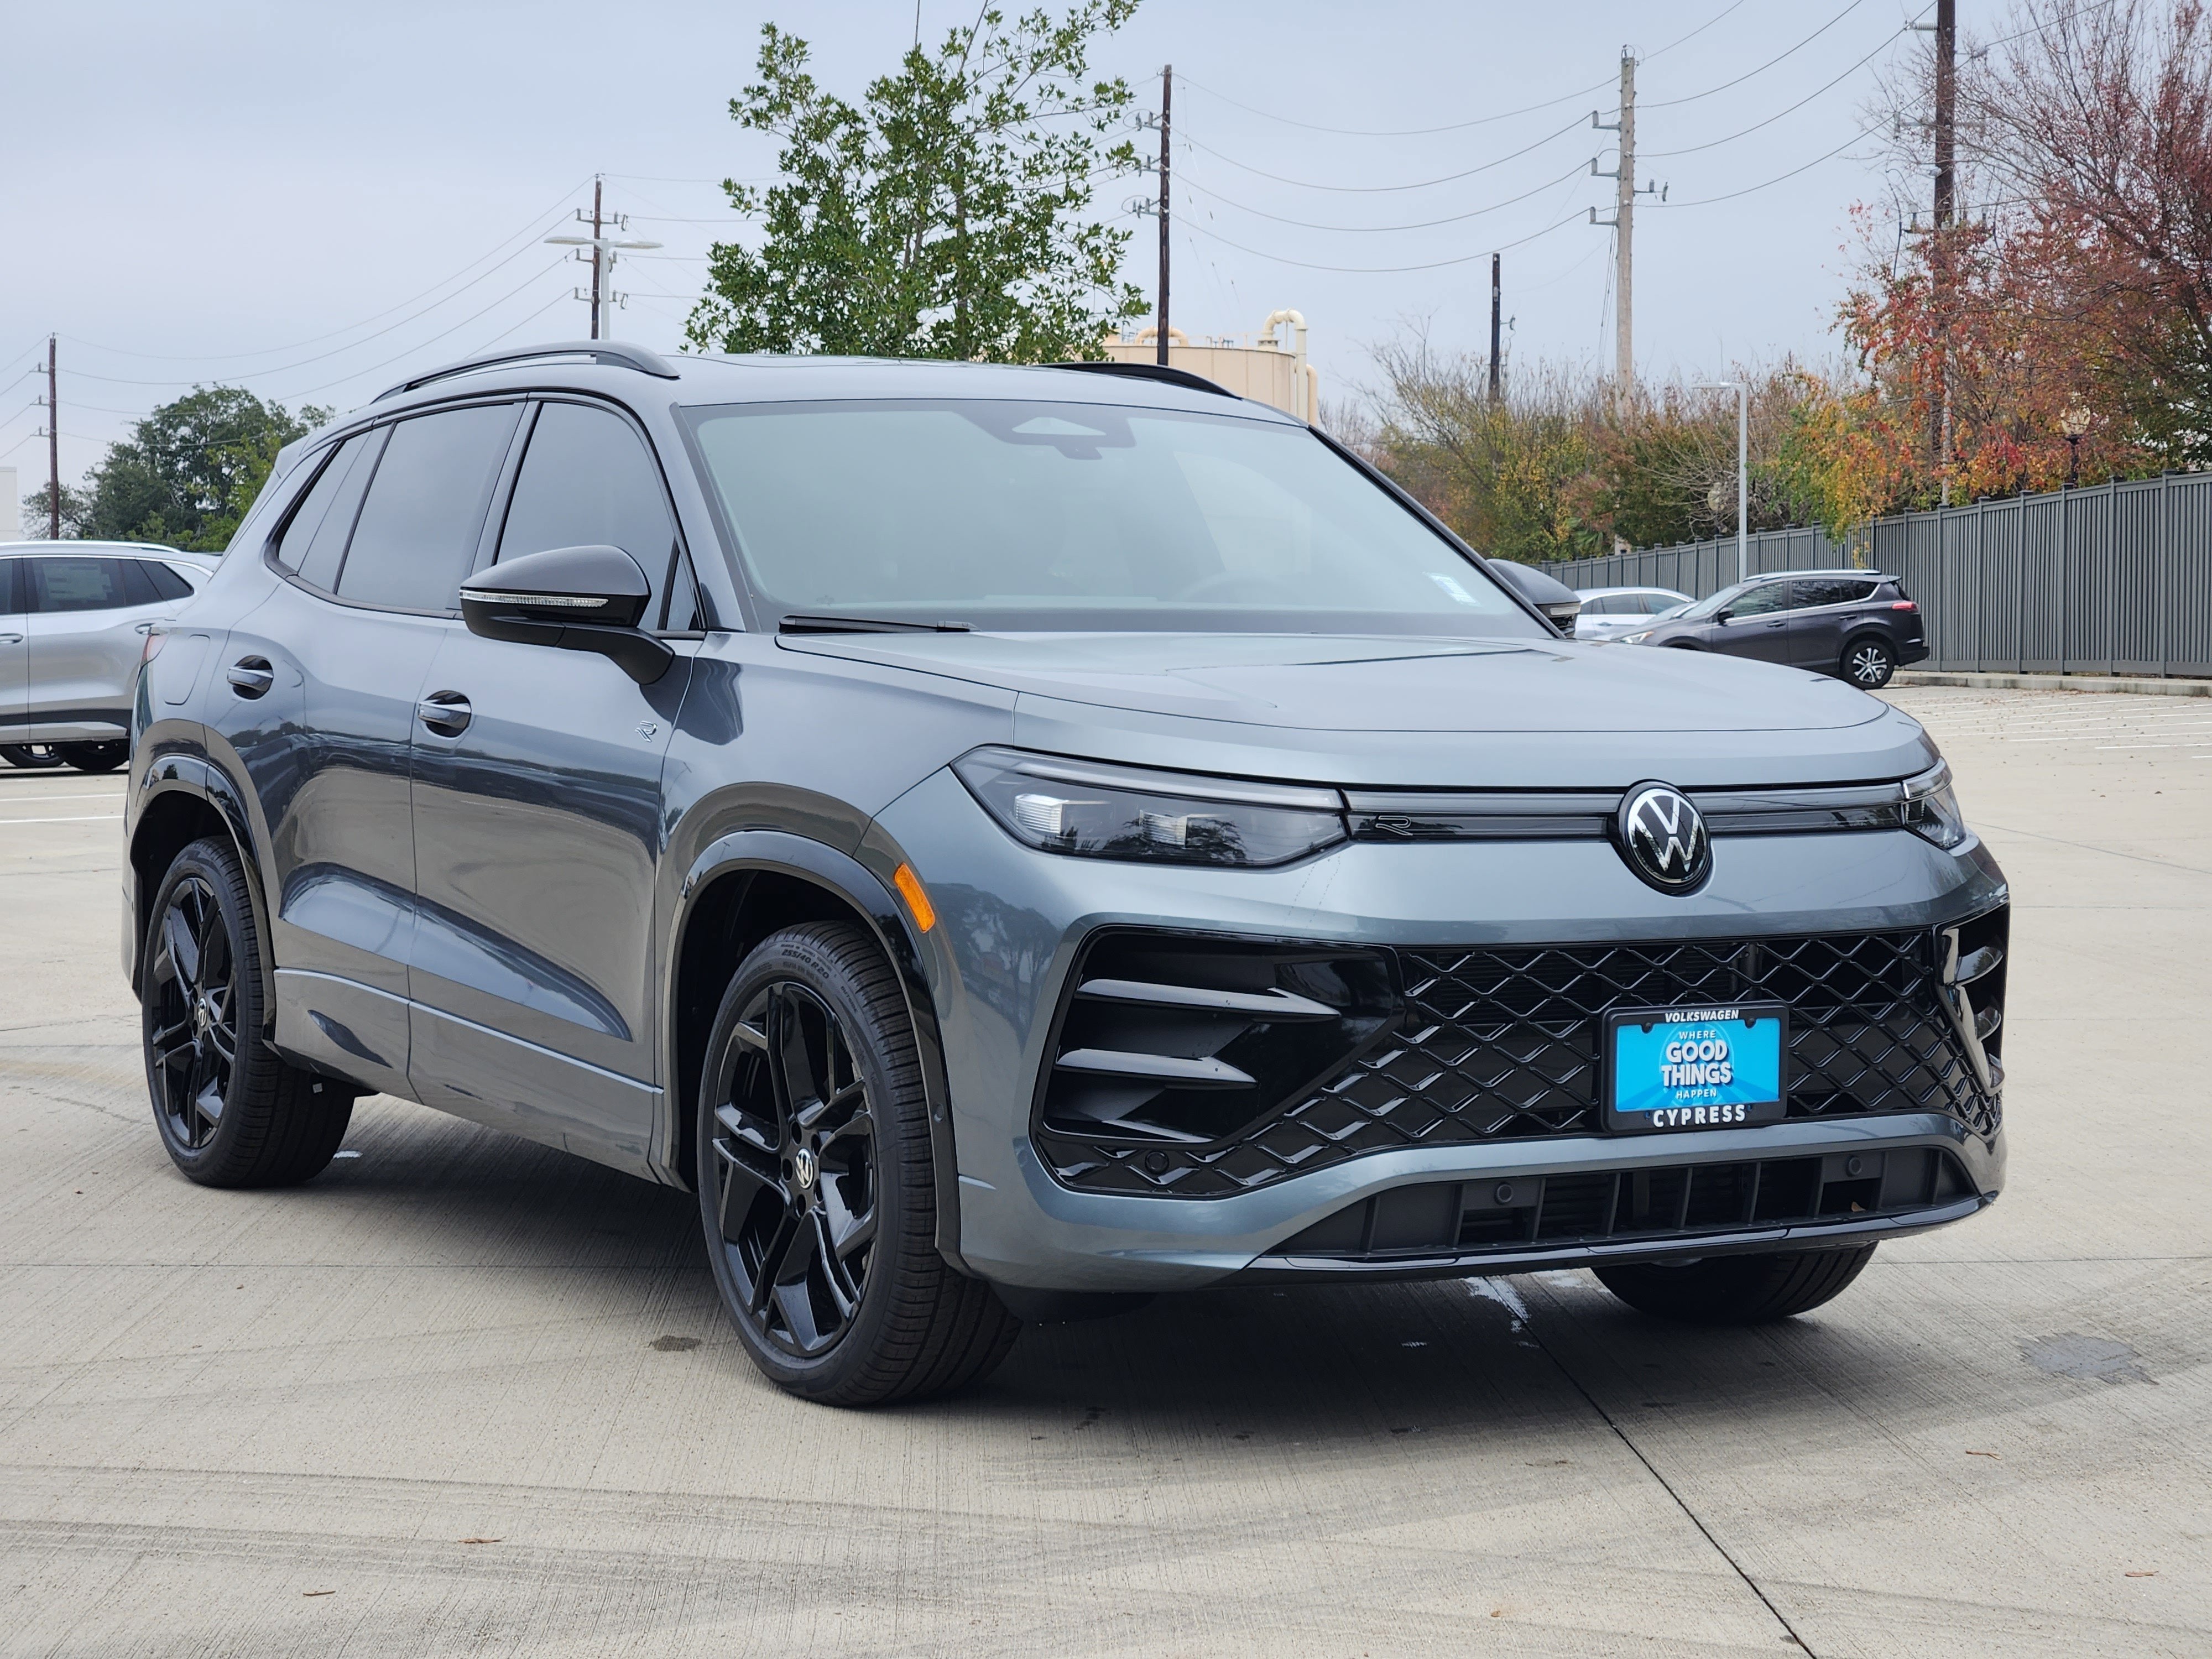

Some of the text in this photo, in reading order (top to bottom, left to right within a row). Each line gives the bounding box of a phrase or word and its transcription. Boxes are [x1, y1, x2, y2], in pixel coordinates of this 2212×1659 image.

[1665, 1009, 1740, 1023] VOLKSWAGEN
[1678, 1030, 1717, 1040] WHERE
[1666, 1040, 1728, 1063] GOOD
[1661, 1062, 1732, 1087] THINGS
[1676, 1089, 1717, 1099] HAPPEN
[1653, 1104, 1746, 1128] CYPRESS
